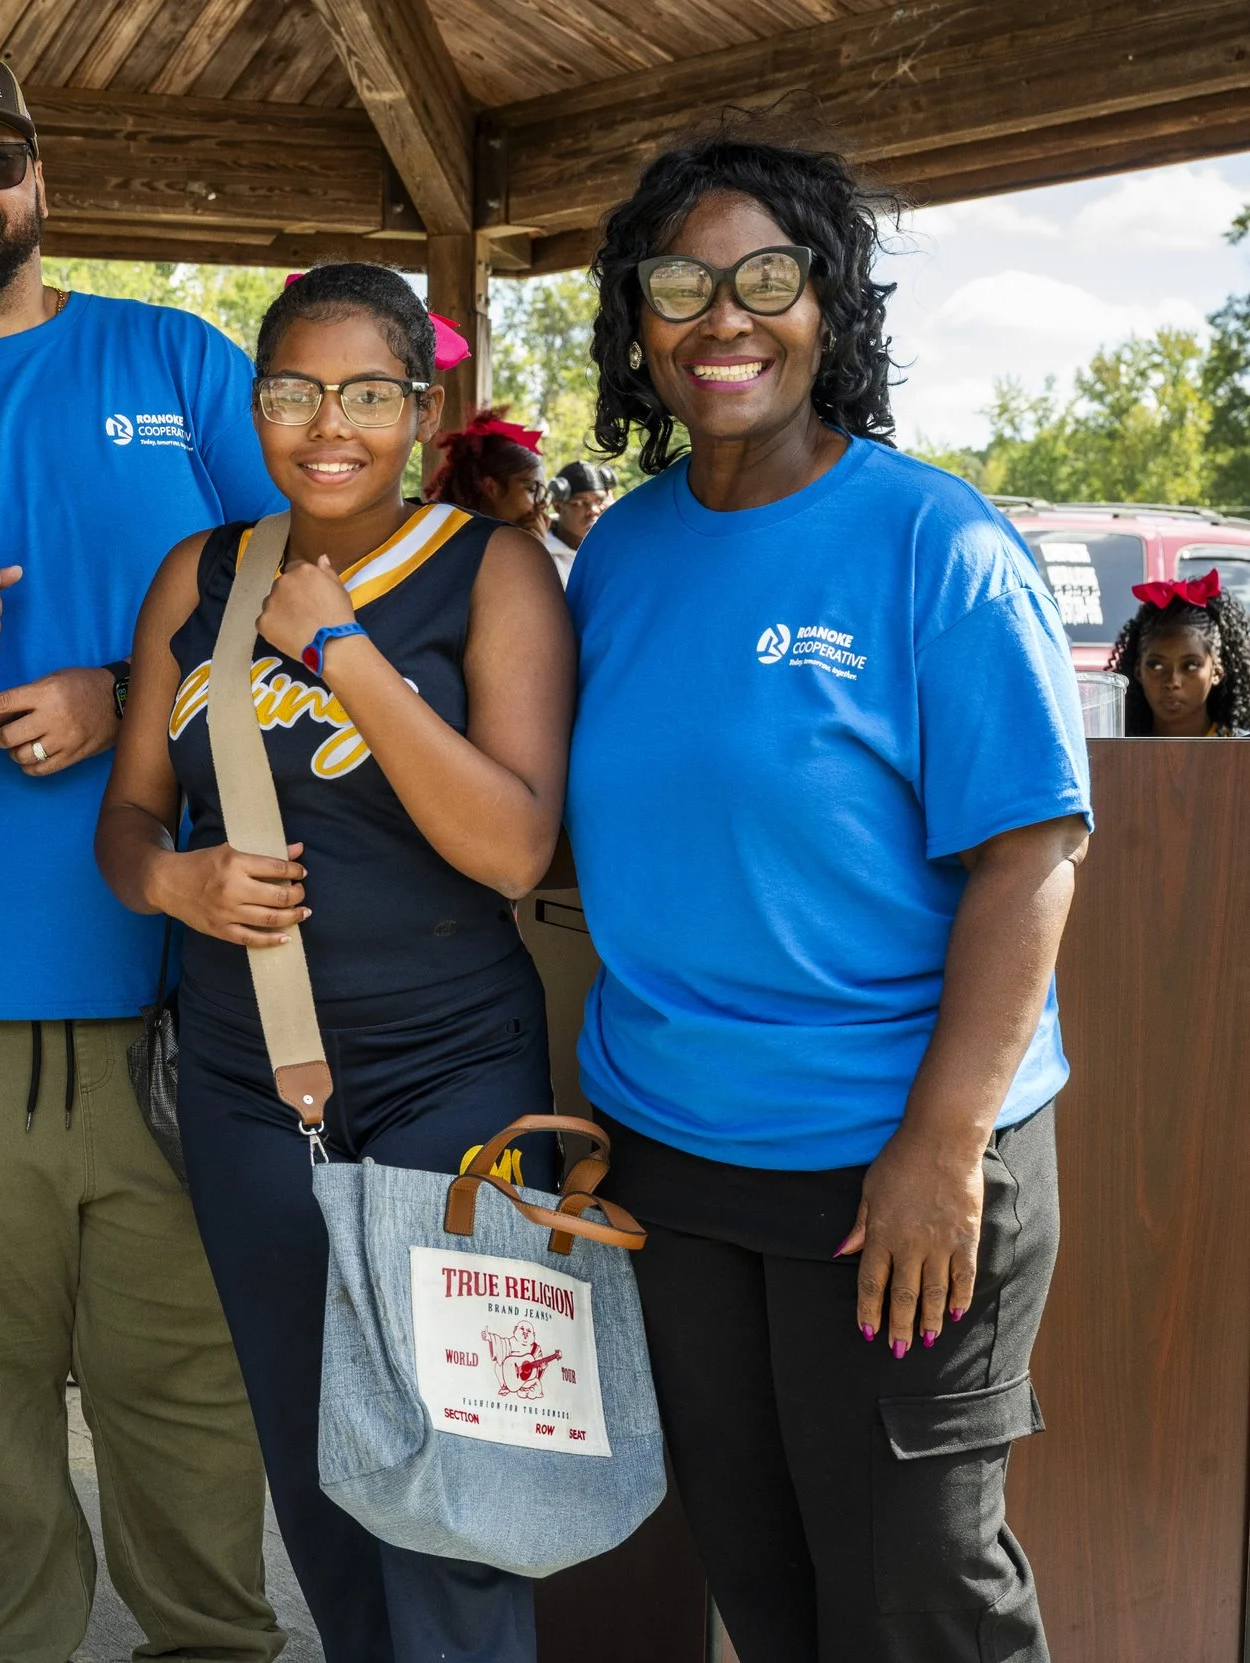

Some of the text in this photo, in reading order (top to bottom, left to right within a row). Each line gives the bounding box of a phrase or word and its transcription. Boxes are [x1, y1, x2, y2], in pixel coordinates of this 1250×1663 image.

[136, 414, 184, 426] ROANOKE
[138, 426, 192, 442] COOPERATIV
[796, 626, 854, 648] ROANOKE
[792, 641, 867, 669] COOPERATIVE
[442, 1267, 574, 1320] TRUE RELIGION
[488, 1303, 519, 1316] BRAND
[445, 1349, 577, 1384] WORLD TOUR
[523, 1405, 538, 1415] THE
[444, 1408, 586, 1440] SECTION ROW SEAT
